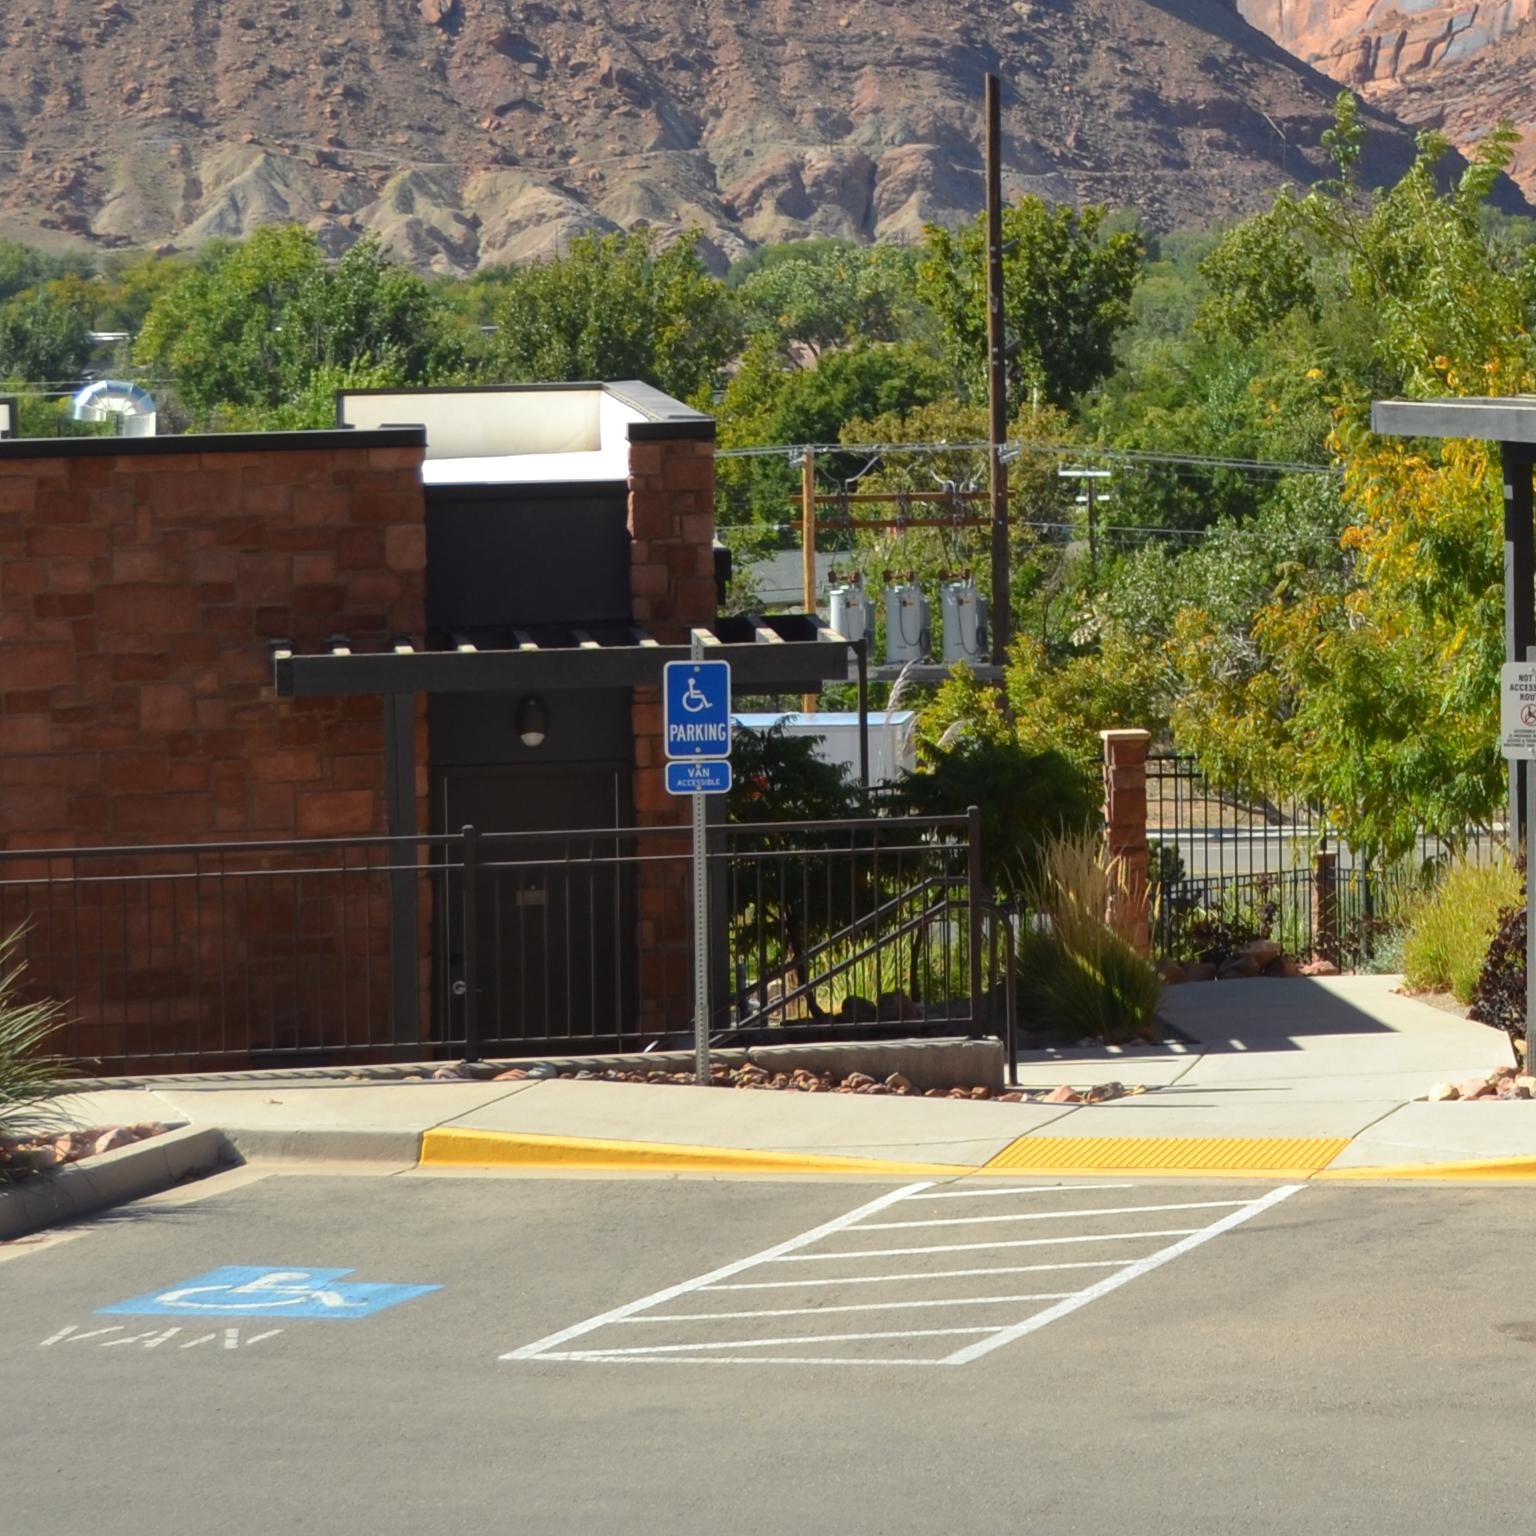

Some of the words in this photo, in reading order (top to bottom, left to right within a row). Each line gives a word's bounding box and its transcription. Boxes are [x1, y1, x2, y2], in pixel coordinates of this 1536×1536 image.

[1518, 674, 1532, 682] NOT
[669, 723, 726, 742] PARKING
[687, 768, 710, 778] VAN
[677, 778, 720, 787] ACCESSIBLE
[39, 1325, 285, 1349] VAN
